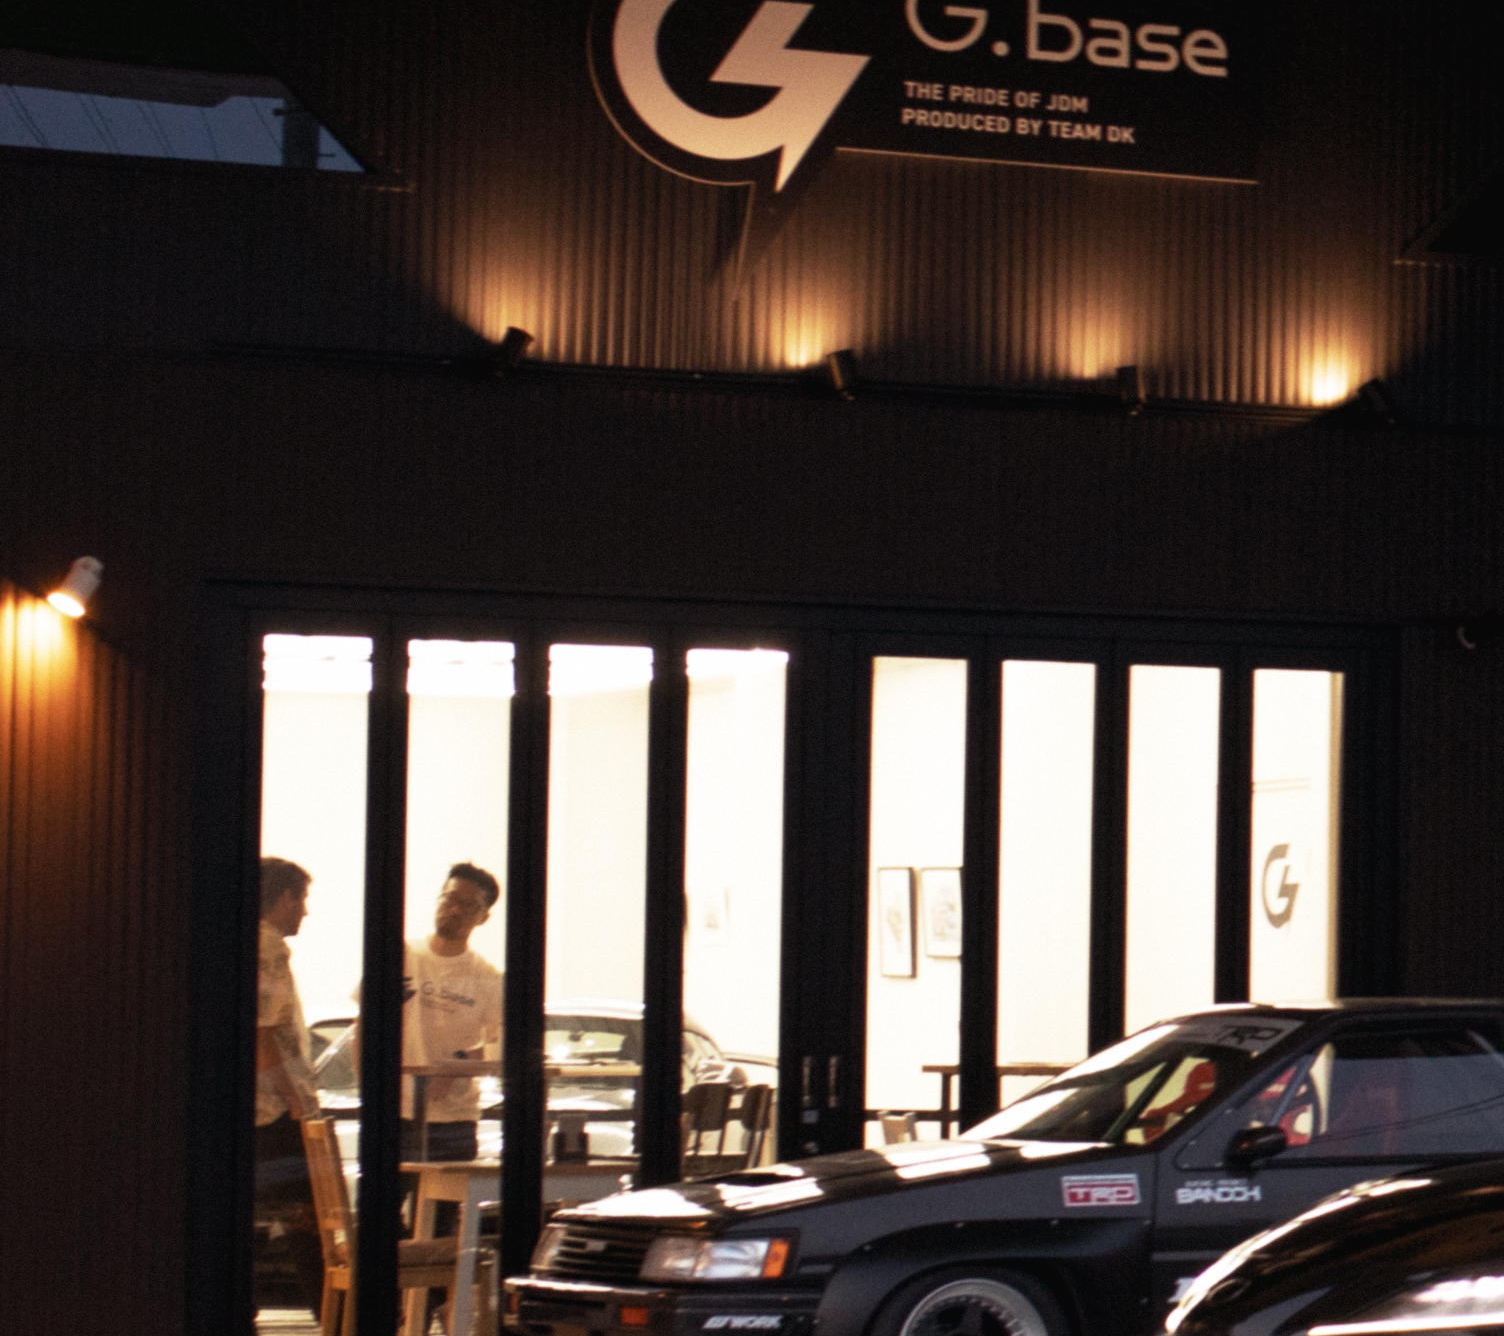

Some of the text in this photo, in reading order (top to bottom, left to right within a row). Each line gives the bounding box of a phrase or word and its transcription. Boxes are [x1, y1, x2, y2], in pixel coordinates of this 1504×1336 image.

[903, 81, 1088, 113] THE PRIDE OF JDM
[901, 108, 1136, 144] PRODUCED BY TEAM DK
